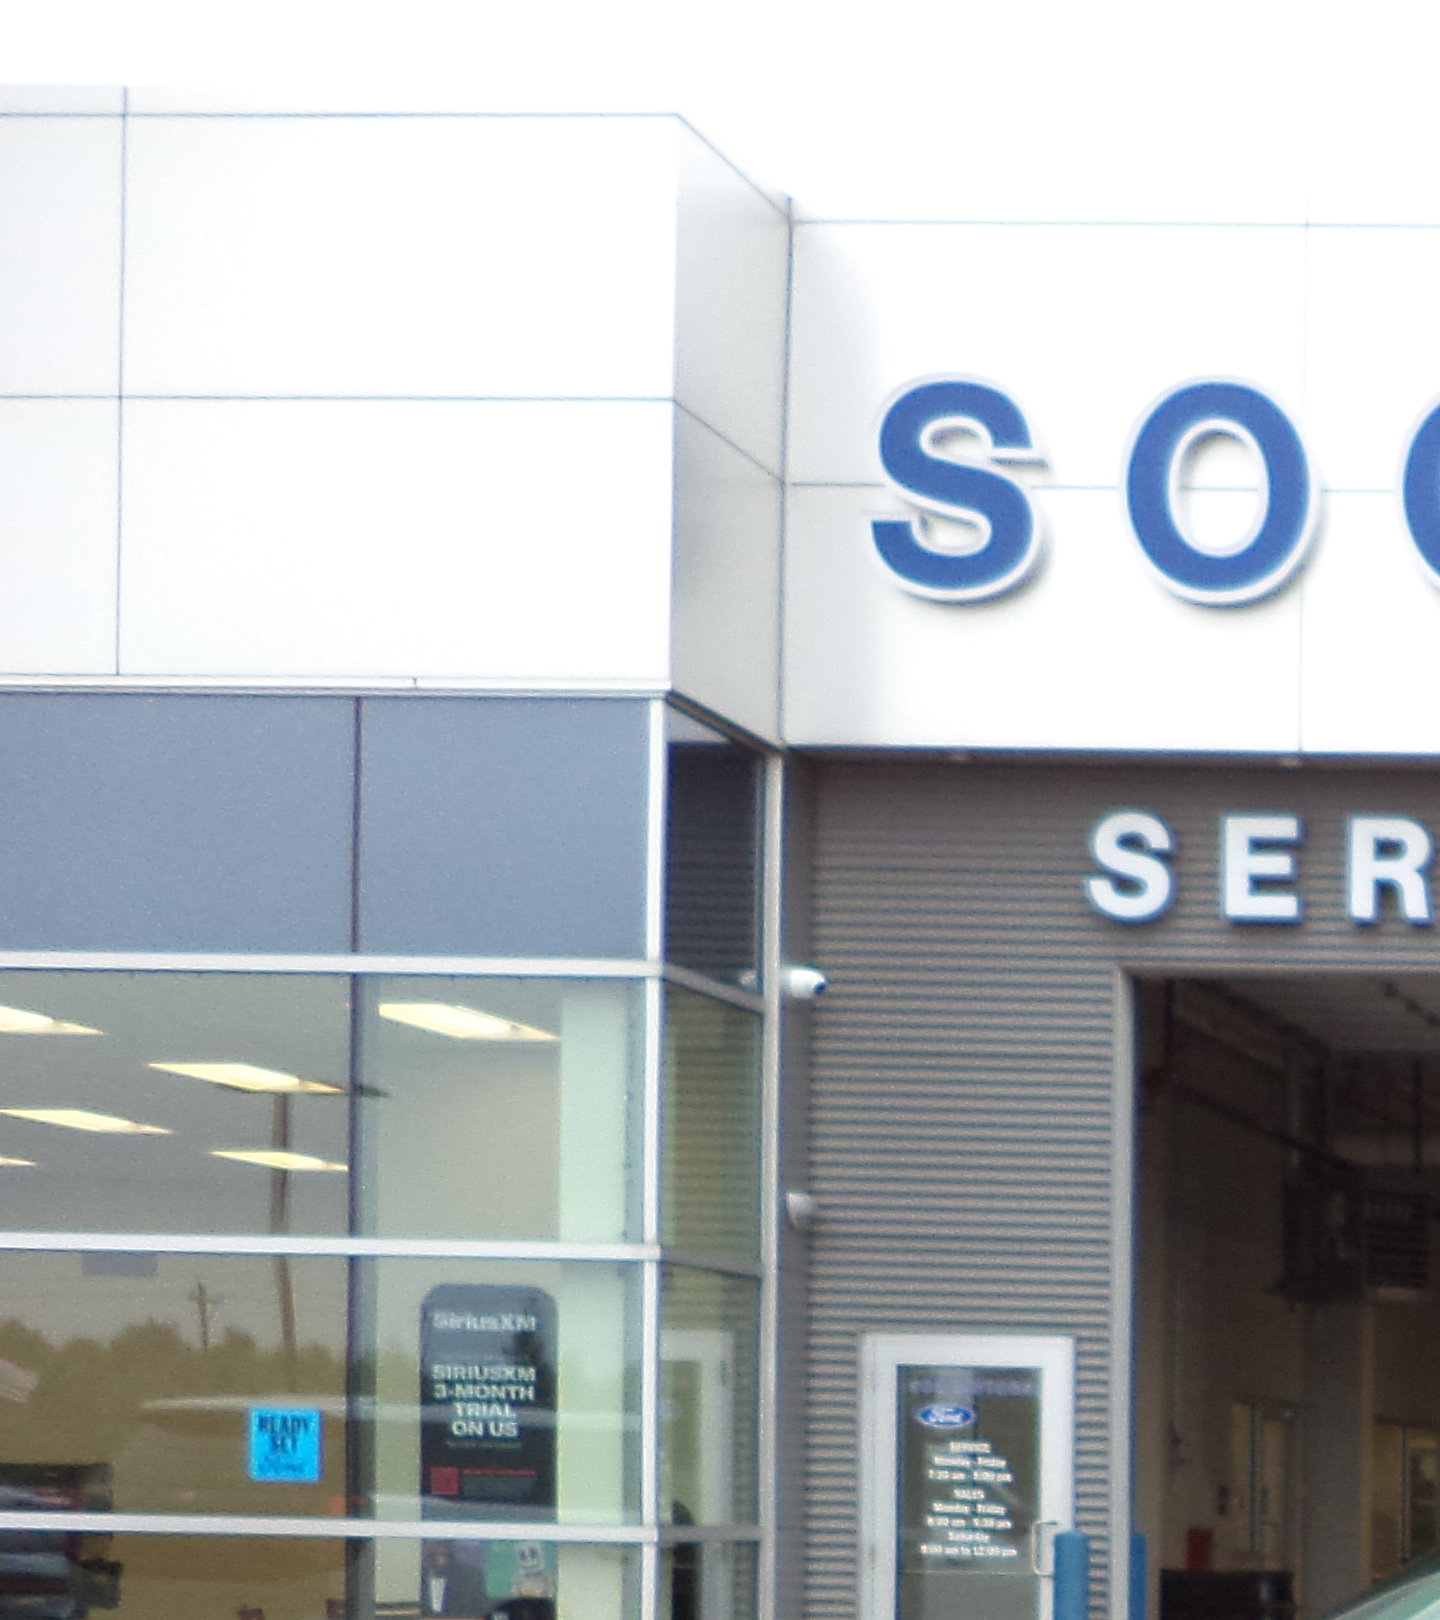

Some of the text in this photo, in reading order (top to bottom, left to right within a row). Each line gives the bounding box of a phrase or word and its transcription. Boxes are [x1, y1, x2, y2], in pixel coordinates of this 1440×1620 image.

[432, 1364, 536, 1382] SIRIUSXM
[432, 1384, 535, 1401] 3-MONTH
[454, 1403, 516, 1418] TRIAL
[452, 1421, 518, 1438] ON US
